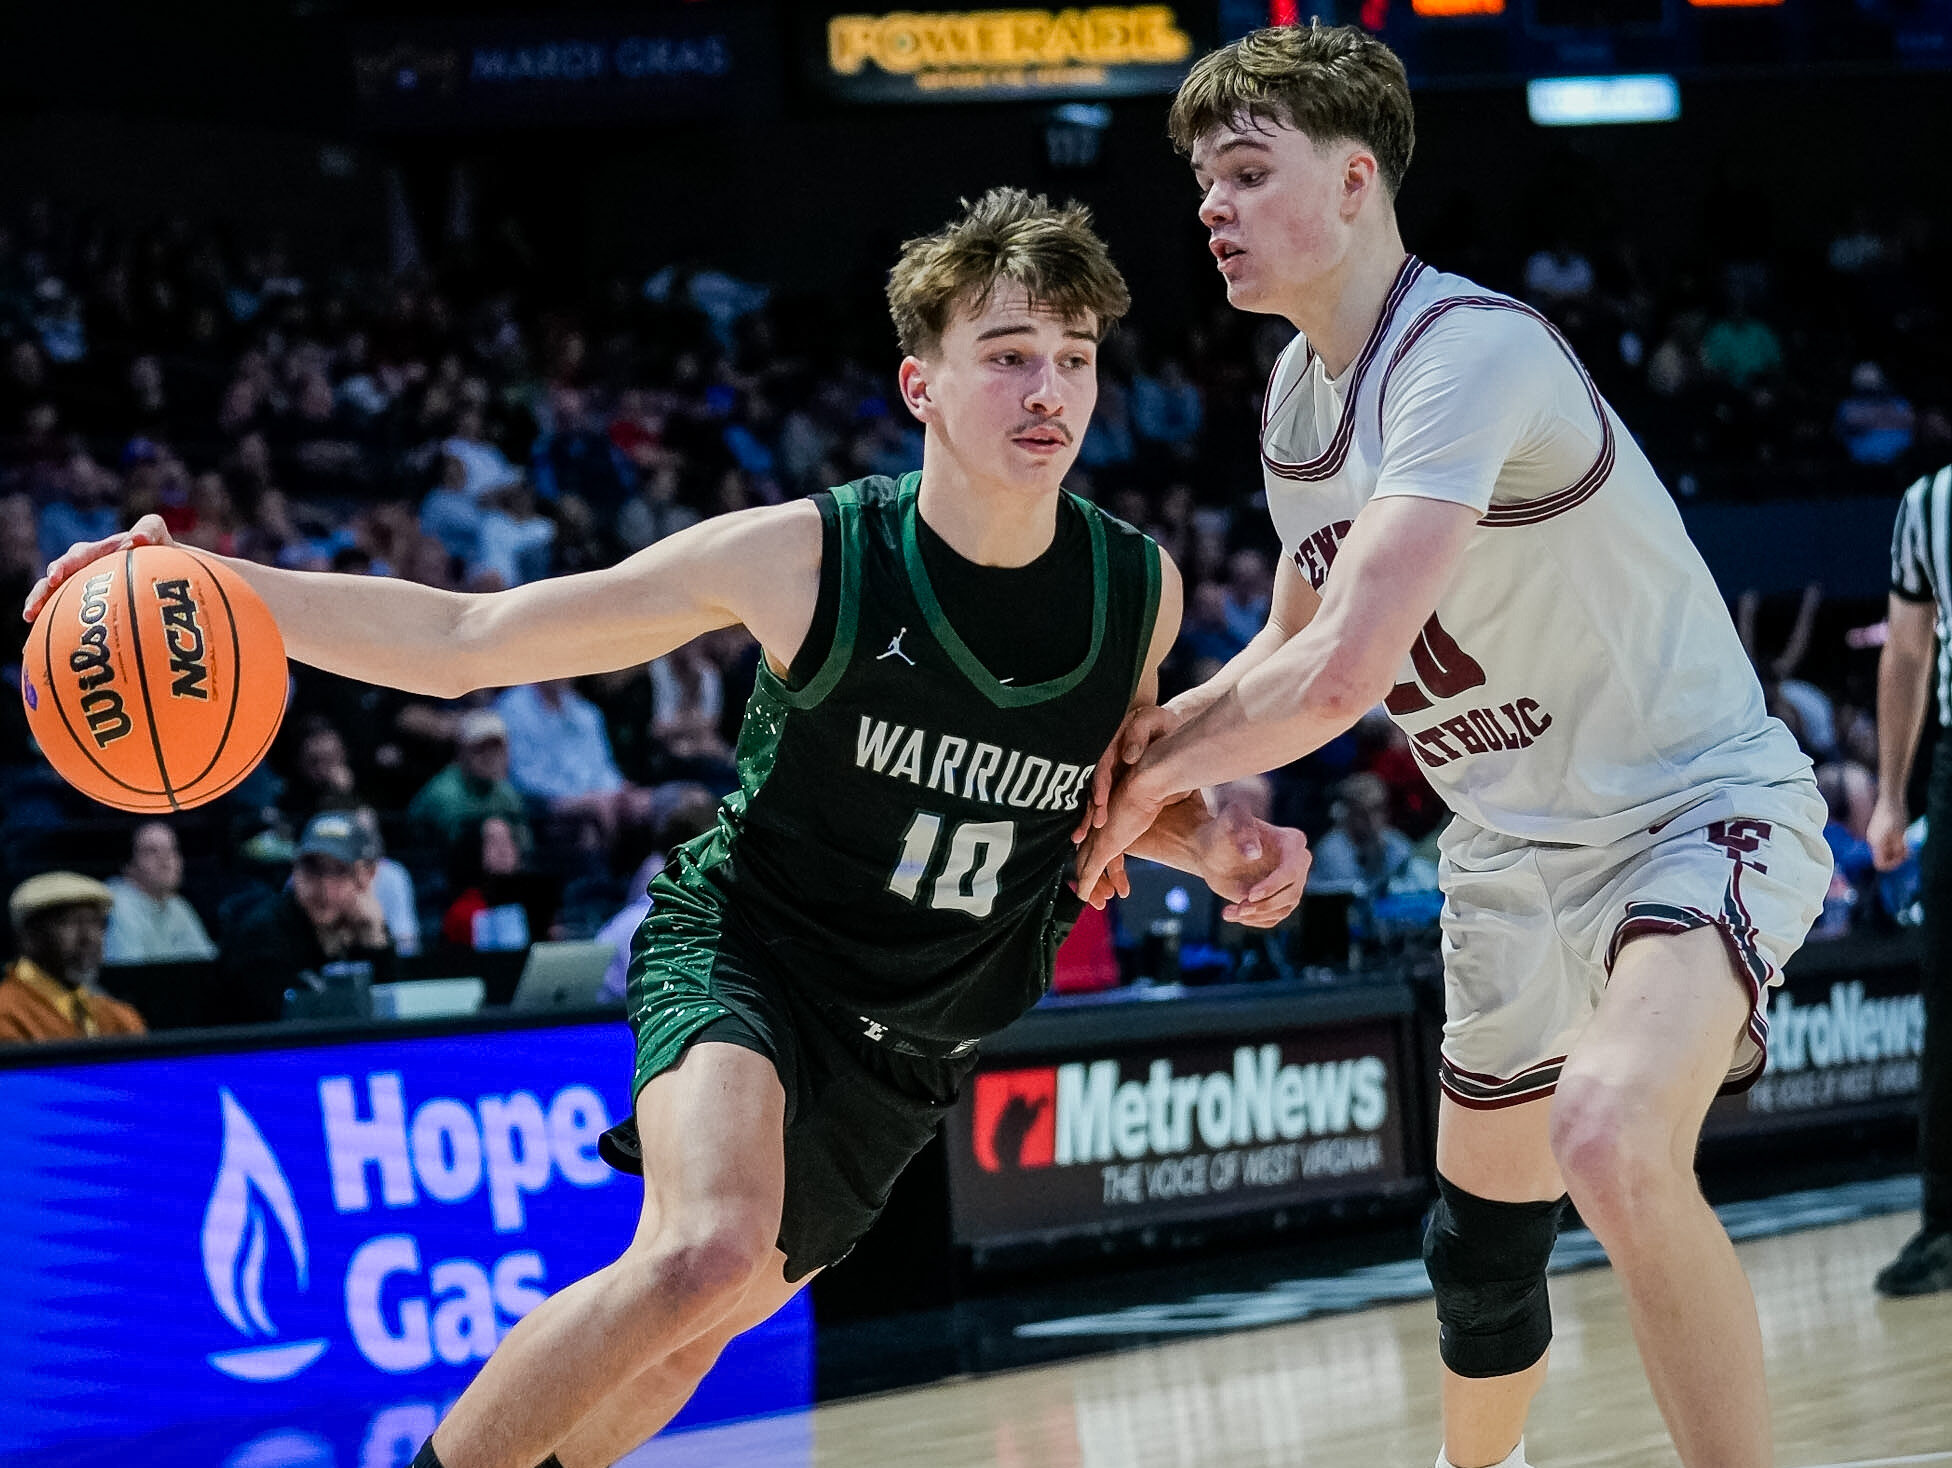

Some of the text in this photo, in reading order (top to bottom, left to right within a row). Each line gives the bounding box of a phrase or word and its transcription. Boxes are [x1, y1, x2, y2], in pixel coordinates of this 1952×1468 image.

[69, 570, 133, 750] Wilson
[153, 577, 209, 702] NCAA
[854, 714, 1097, 812] WARRIORS
[886, 809, 1016, 919] 10
[318, 1070, 613, 1232] Hope
[1055, 1042, 1387, 1166] MetroNews
[1102, 1163, 1145, 1203] THE
[1148, 1154, 1209, 1198] VOICE
[1209, 1150, 1240, 1192] OF
[344, 1233, 550, 1377] Gas
